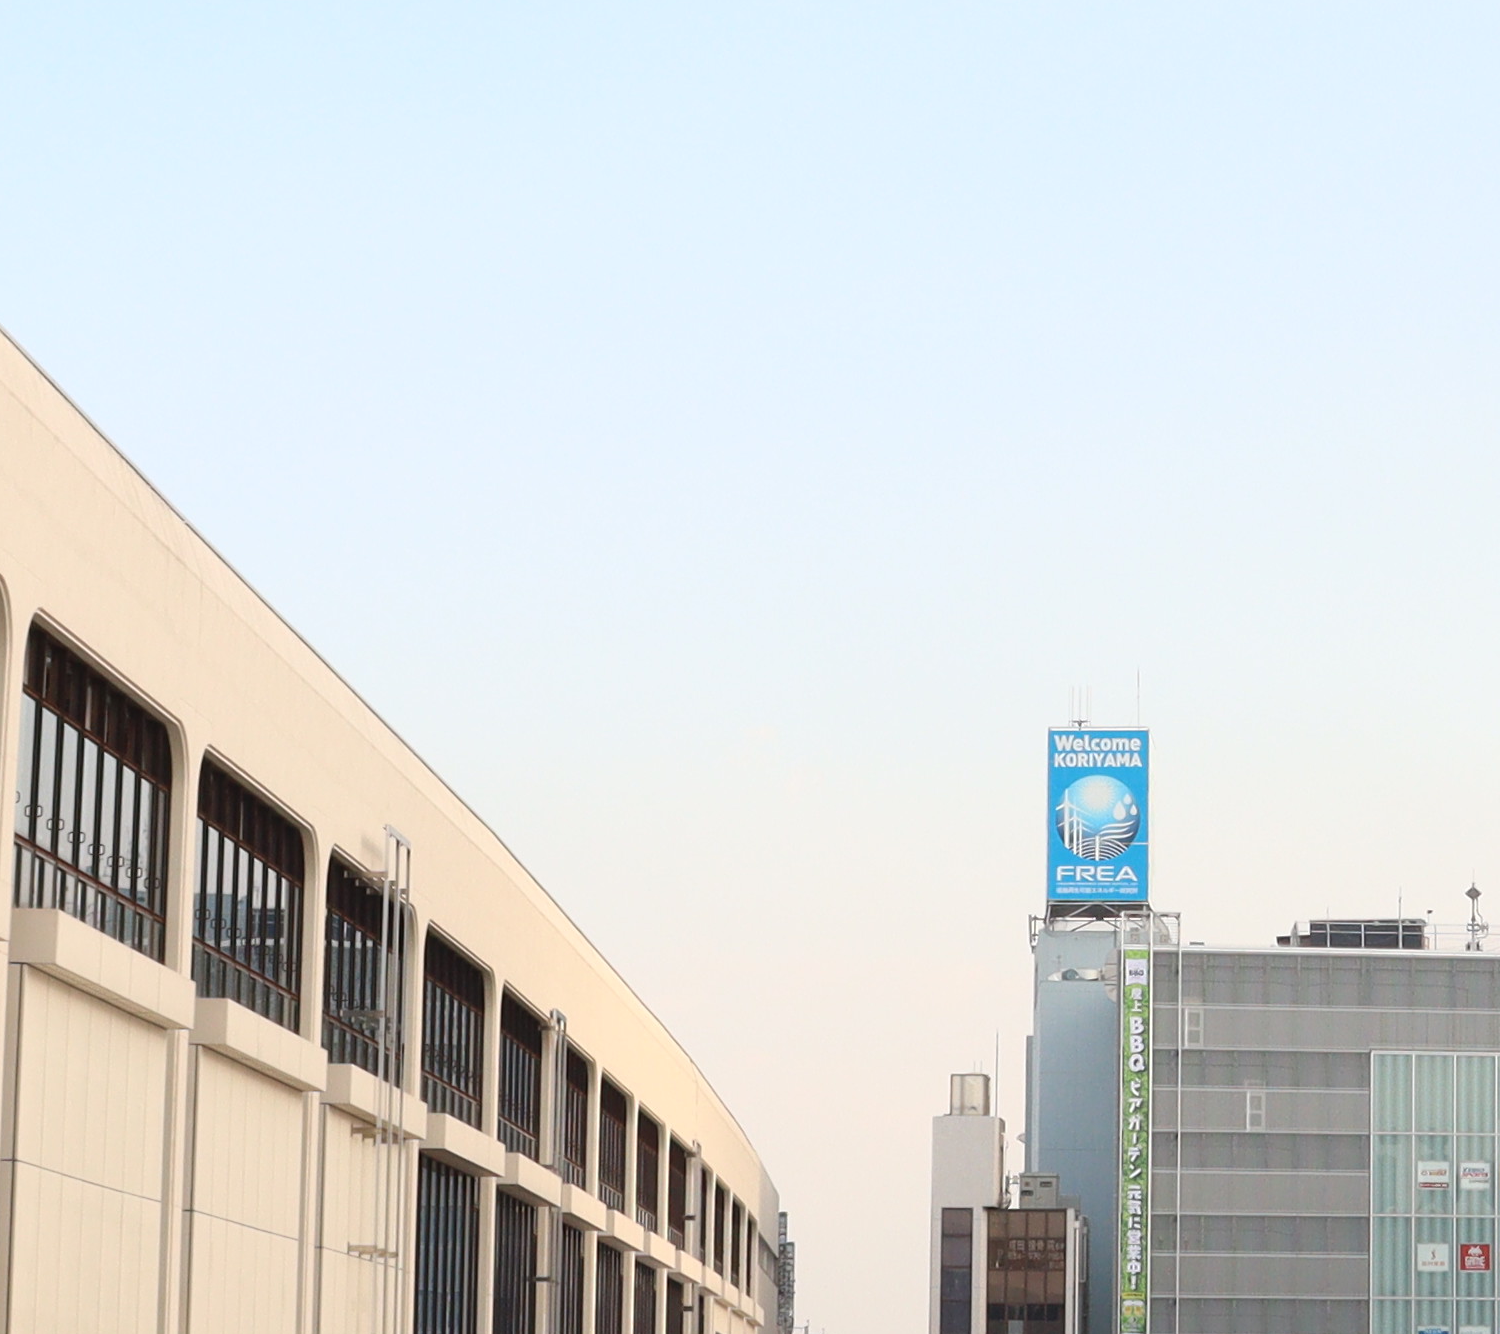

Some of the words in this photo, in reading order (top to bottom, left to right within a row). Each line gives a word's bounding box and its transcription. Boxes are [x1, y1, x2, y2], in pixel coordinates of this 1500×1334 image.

[1054, 734, 1142, 752] Welcome
[1054, 752, 1143, 768] KORIYAMA
[1056, 865, 1138, 882] FREA
[1129, 1015, 1146, 1073] BBQ
[1128, 1079, 1144, 1179] ビアガーデン
